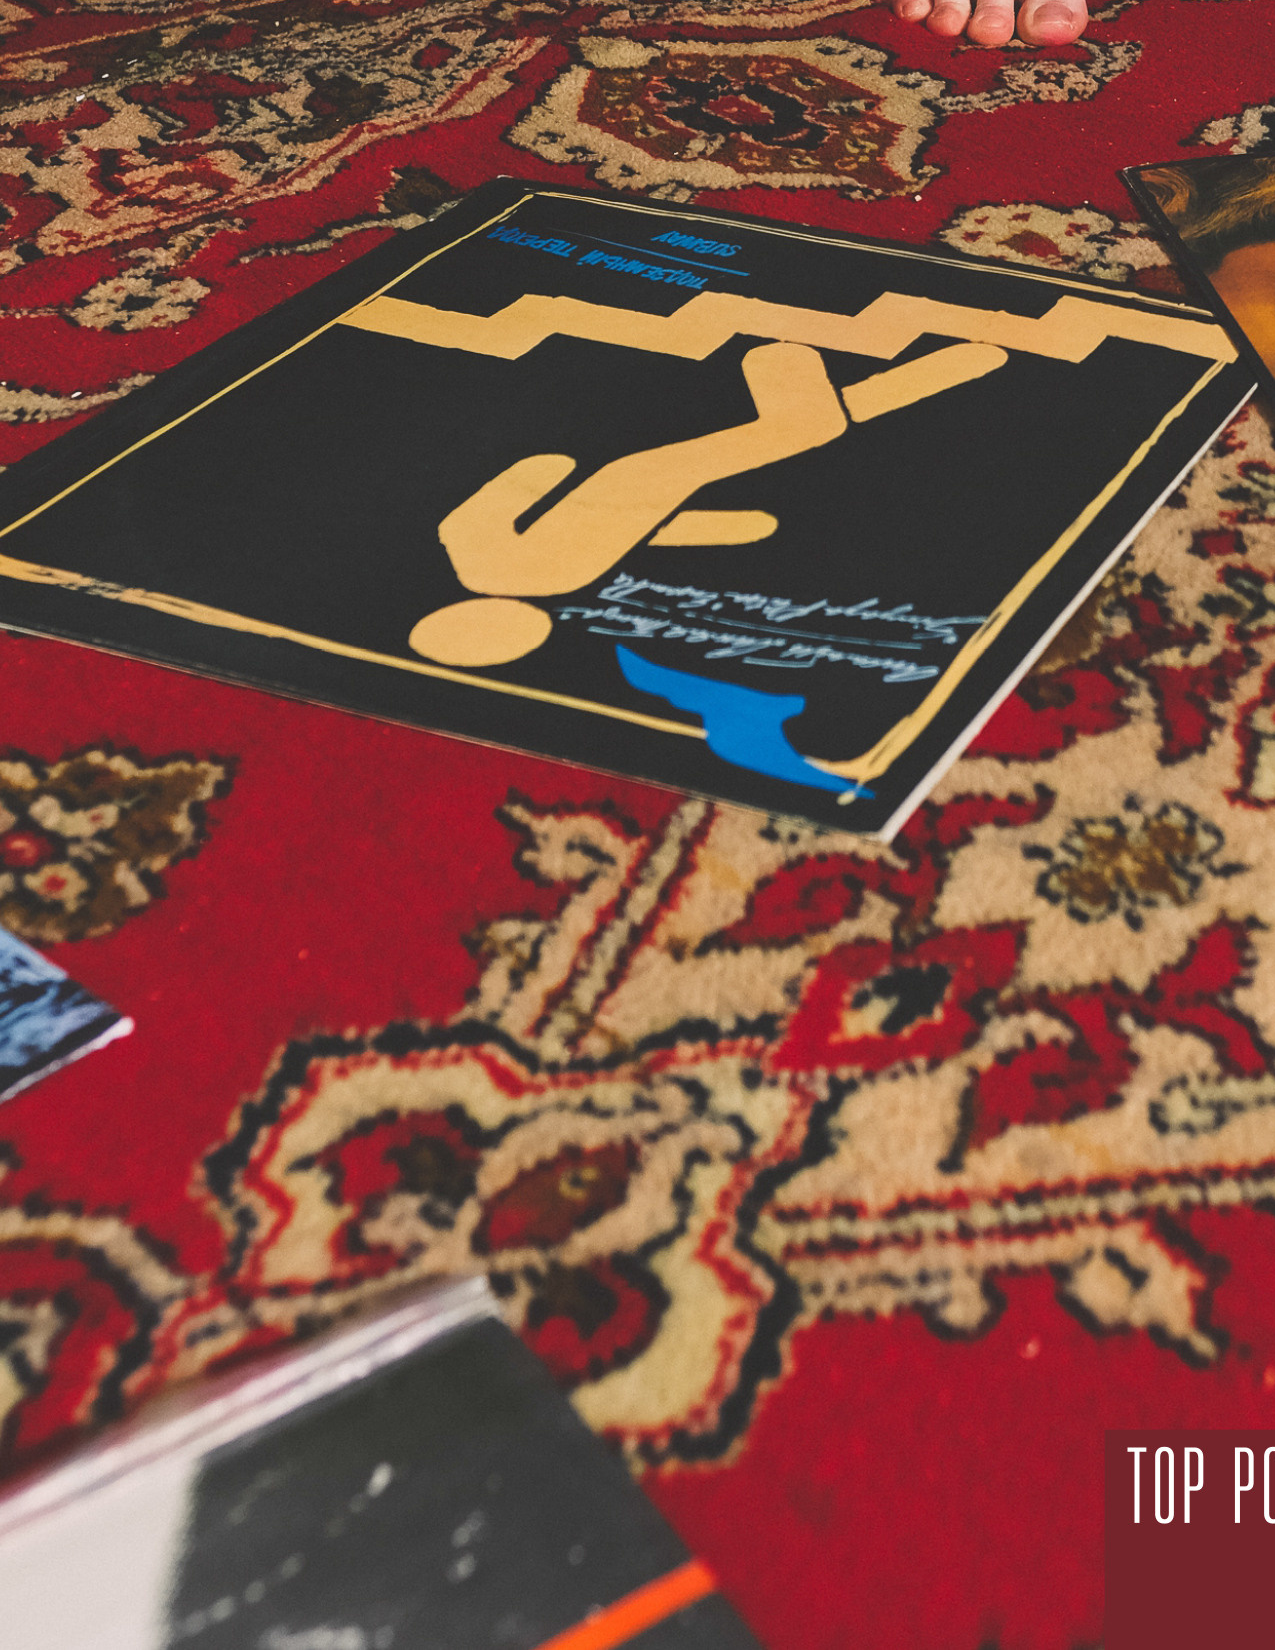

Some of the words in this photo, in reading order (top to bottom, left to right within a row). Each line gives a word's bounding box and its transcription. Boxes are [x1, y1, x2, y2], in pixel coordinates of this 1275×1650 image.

[486, 225, 578, 258] ПЕРЕХОД
[651, 230, 742, 257] SUBWAY
[576, 249, 709, 290] ПОДЗЕМНЫЙ
